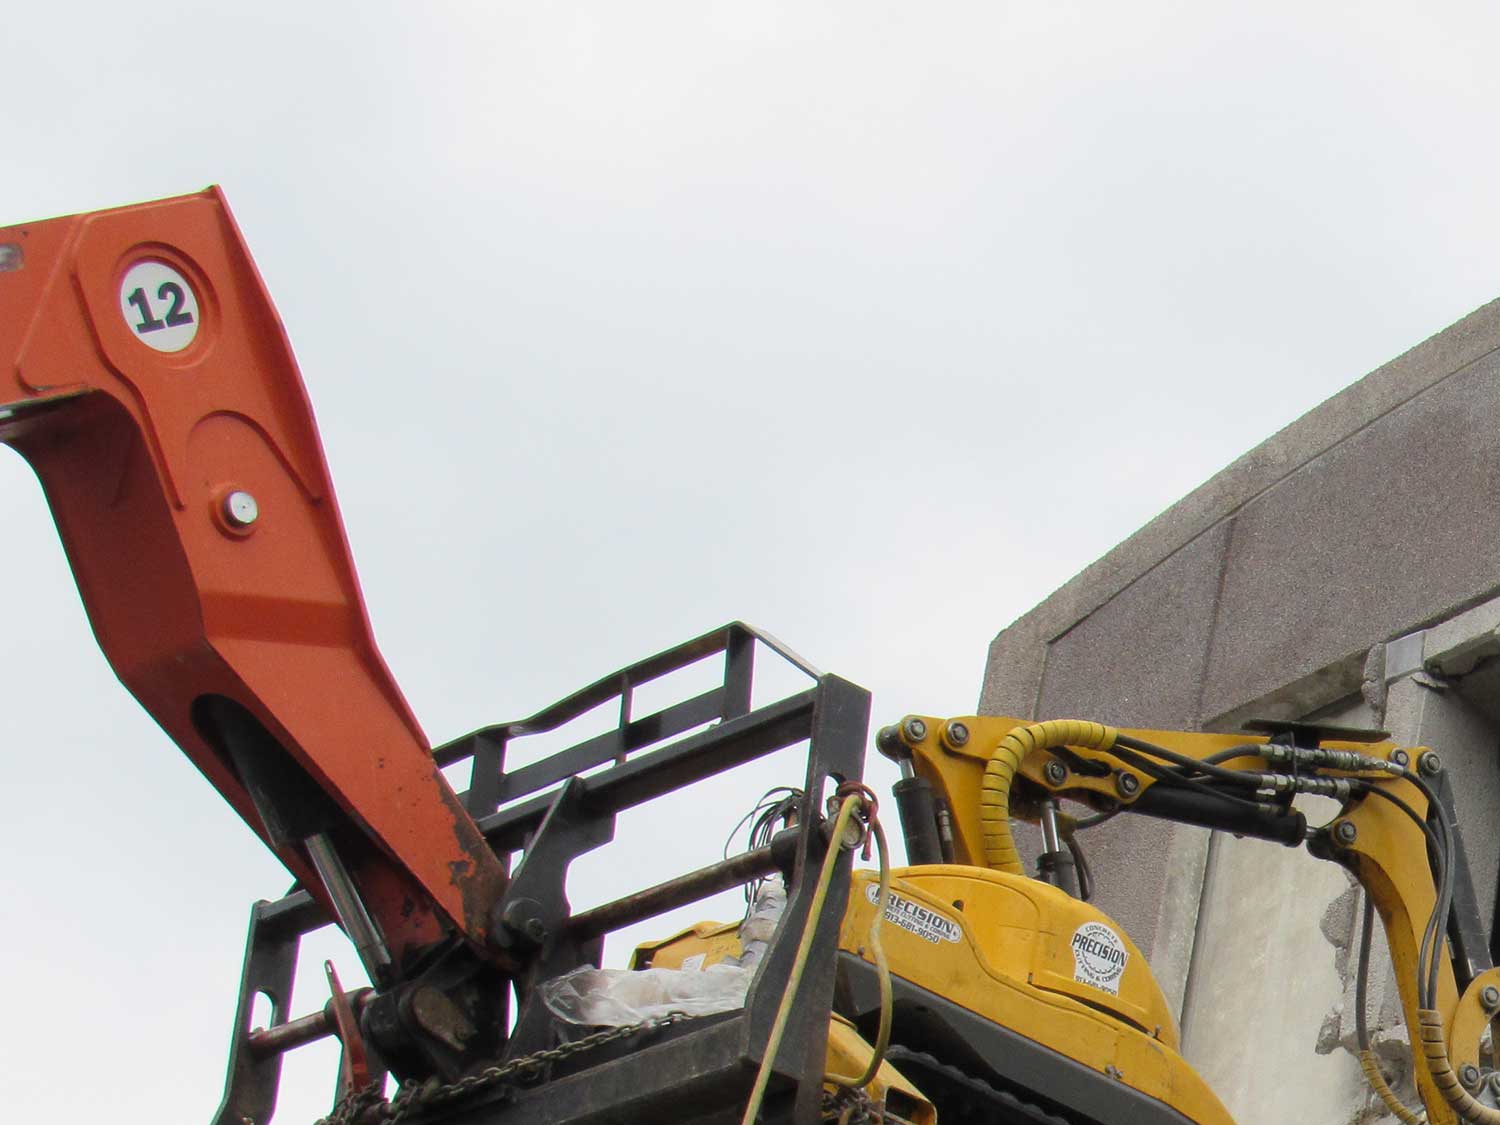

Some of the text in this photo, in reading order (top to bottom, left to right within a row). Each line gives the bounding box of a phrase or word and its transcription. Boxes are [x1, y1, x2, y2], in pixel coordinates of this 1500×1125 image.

[128, 281, 194, 334] 12
[884, 911, 939, 944] 913-681-9050
[1072, 932, 1128, 967] PRECISION
